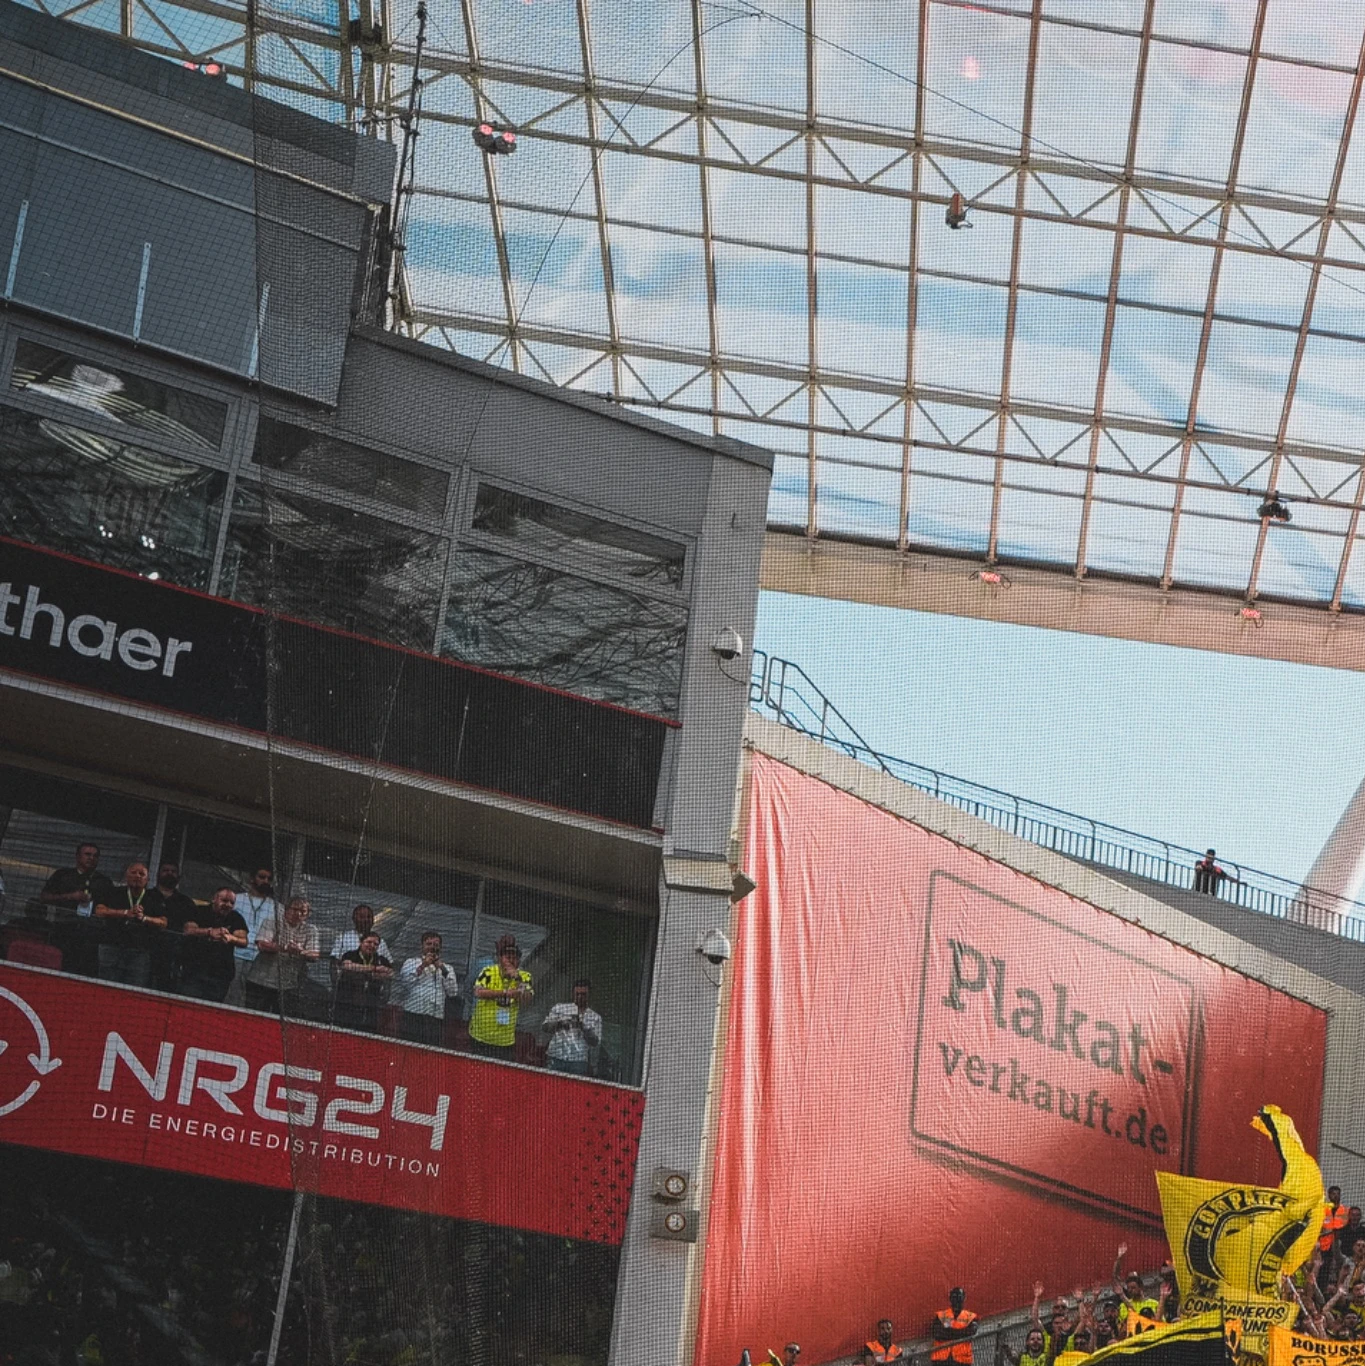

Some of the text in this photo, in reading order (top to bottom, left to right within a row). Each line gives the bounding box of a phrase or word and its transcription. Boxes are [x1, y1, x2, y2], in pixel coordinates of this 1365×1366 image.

[942, 938, 1175, 1086] Plakat-
[92, 1103, 442, 1177] DIE ENERGIEDISTRIBUTION
[97, 1031, 450, 1151] NRG24
[938, 1042, 1169, 1155] verkauft.de
